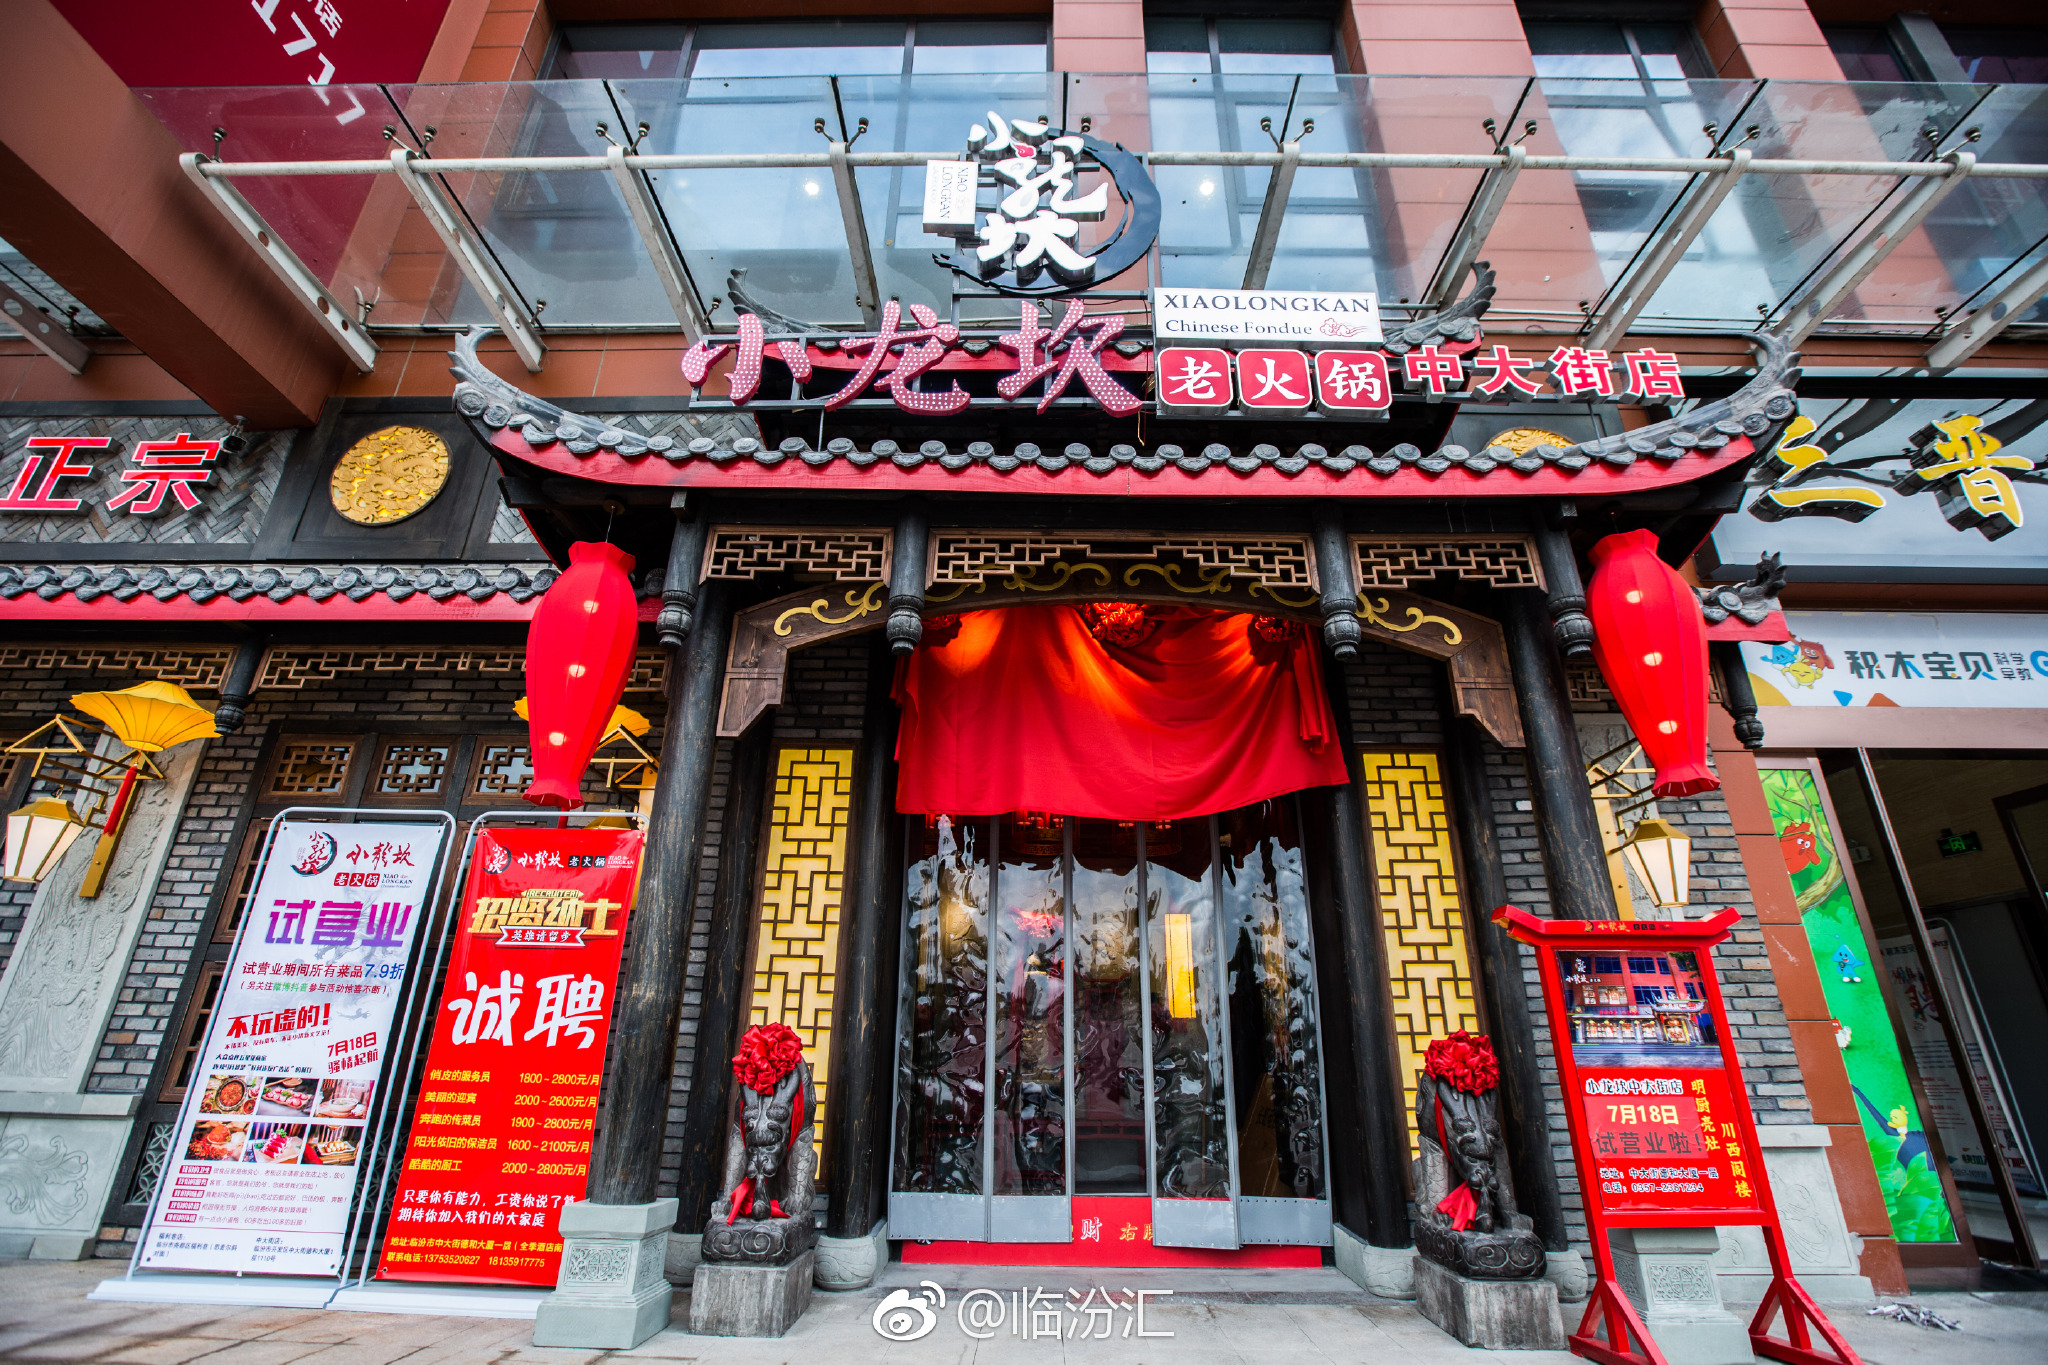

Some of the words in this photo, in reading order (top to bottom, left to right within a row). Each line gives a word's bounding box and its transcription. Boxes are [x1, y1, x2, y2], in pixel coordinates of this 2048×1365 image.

[1164, 294, 1370, 313] XIAOLONGKAN
[1165, 319, 1240, 334] Chinese
[1244, 321, 1313, 335] Fondue
[681, 300, 1143, 418] 小龙坎
[1167, 355, 1383, 402] 老火锅
[1402, 344, 1687, 399] 中大街店
[0, 432, 220, 514] 正宗
[1844, 650, 1998, 681] 积木宝贝
[568, 856, 606, 868] 老火锅
[334, 872, 381, 887] 老火锅
[264, 899, 413, 948] 试营业
[467, 895, 622, 936] 招贤纳士
[511, 929, 572, 942] 英雄请留步
[447, 969, 605, 1050] 诚聘
[327, 1031, 377, 1058] 7月18日
[429, 1069, 491, 1083] 俏皮的服务员
[1586, 1078, 1684, 1095] 小龙坎中大街店
[424, 1091, 477, 1104] 美丽的迎宾
[419, 1113, 481, 1127] 奔跑的传菜员
[1606, 1104, 1680, 1125] 7月18日
[1690, 1078, 1721, 1152] 明厨亮灶
[413, 1136, 497, 1150] 阳光依旧的保洁员
[1596, 1131, 1703, 1155] 试营业啦！
[408, 1158, 463, 1172] 酷酷的厨工
[1720, 1121, 1753, 1199] 川西阁楼
[397, 1208, 545, 1228] 期待你加入我们的大家庭
